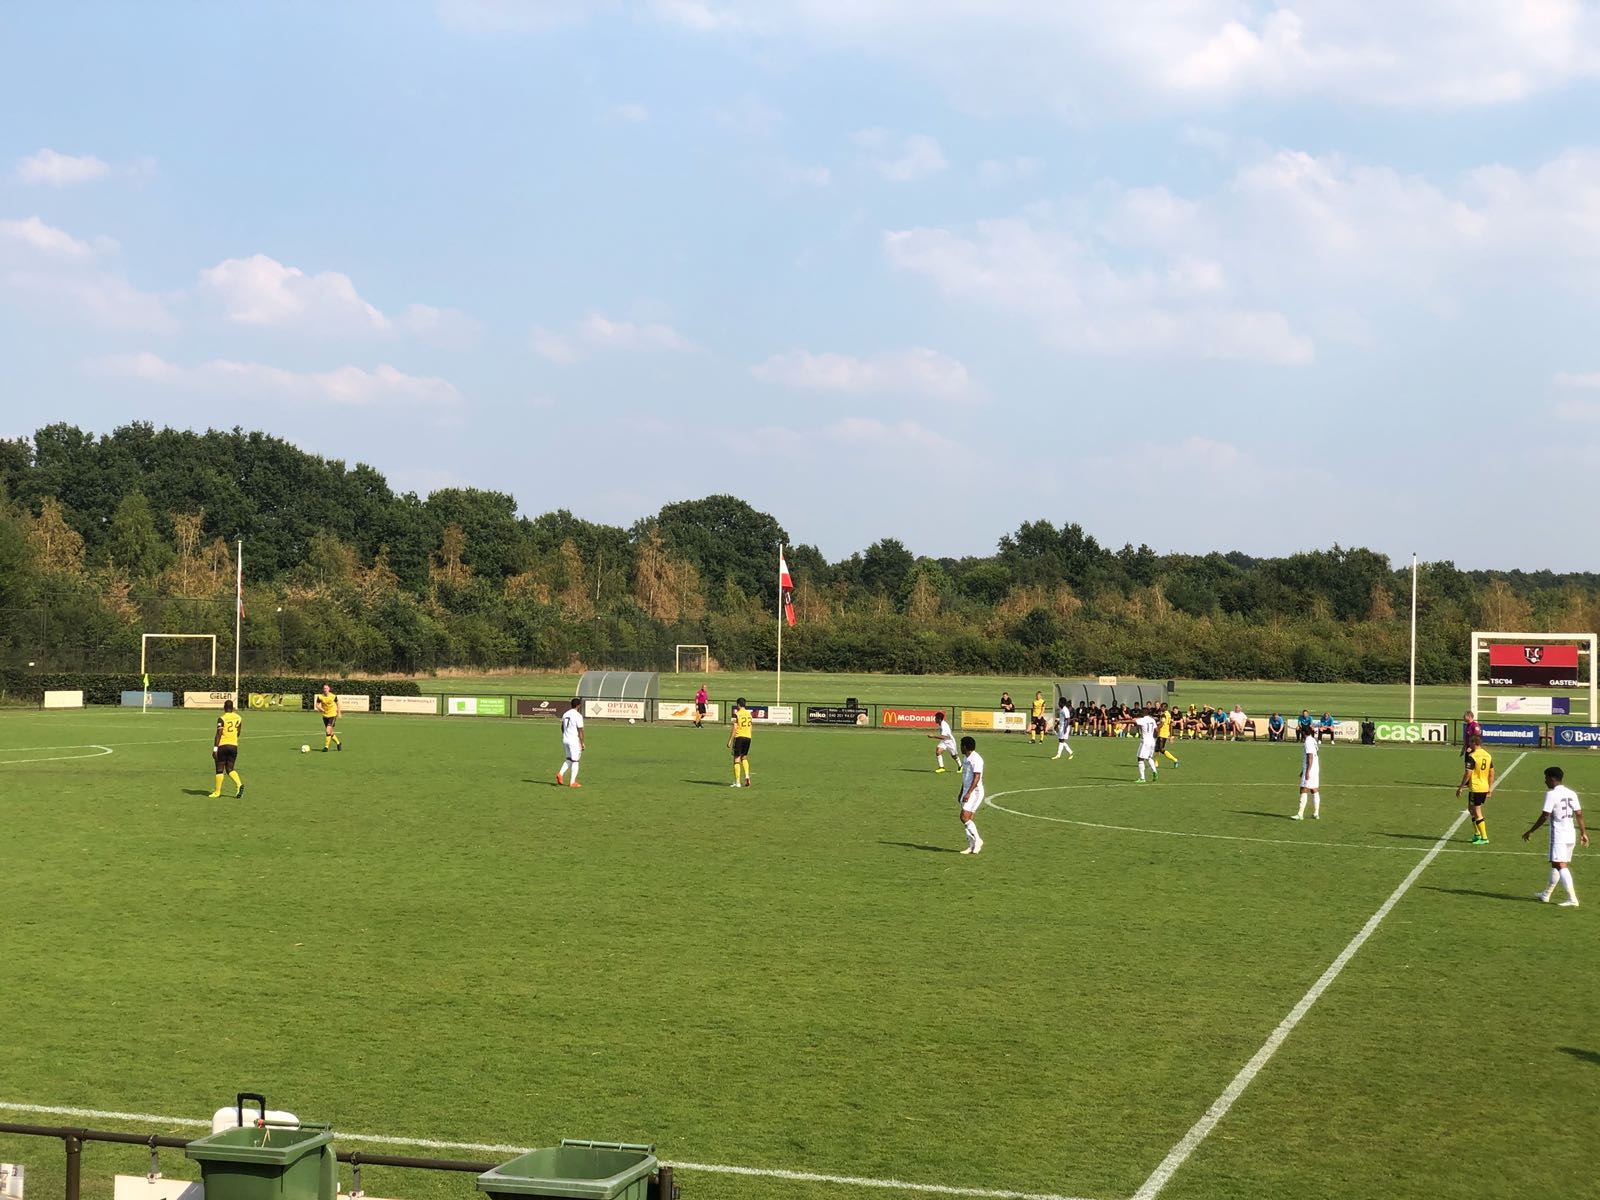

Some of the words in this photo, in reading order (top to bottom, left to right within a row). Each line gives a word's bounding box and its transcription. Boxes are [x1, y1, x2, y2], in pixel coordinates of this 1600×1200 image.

[564, 716, 571, 729] 7
[741, 716, 752, 727] 22
[1147, 722, 1154, 733] 17
[1376, 723, 1447, 741] cas.nl
[1480, 758, 1487, 771] 8
